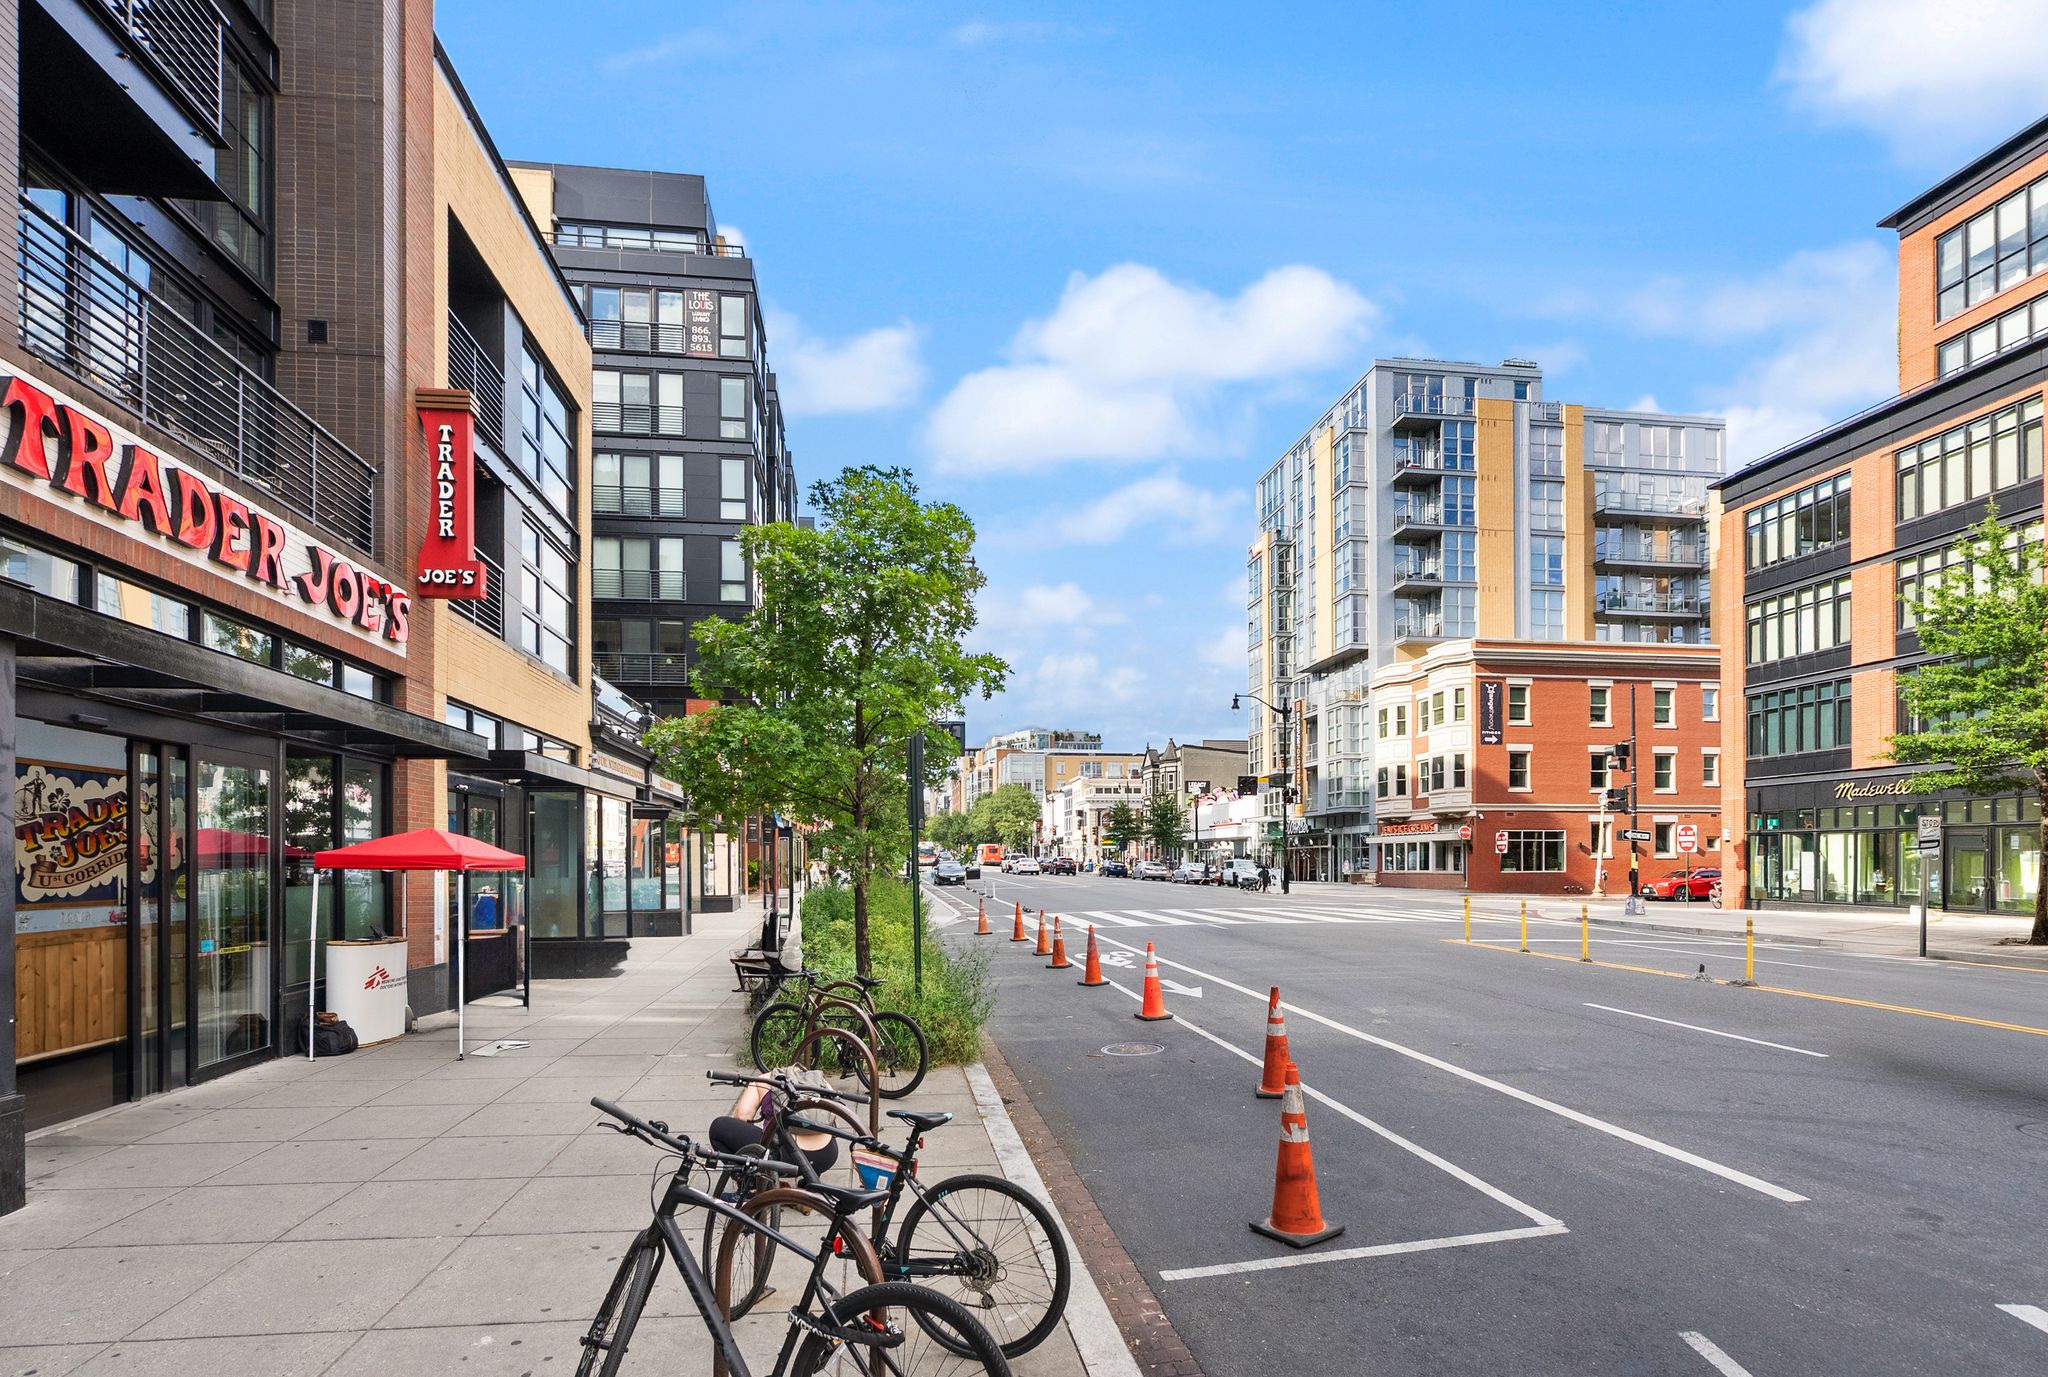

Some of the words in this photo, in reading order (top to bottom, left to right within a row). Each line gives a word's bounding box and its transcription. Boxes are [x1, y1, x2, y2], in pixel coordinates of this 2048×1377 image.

[692, 291, 711, 301] THE
[688, 300, 714, 311] LOUIS
[690, 344, 713, 352] 5615
[436, 424, 456, 538] TRADER
[0, 376, 289, 590] TRADER
[292, 546, 412, 644] JOE'S
[418, 568, 476, 585] JOE'S
[1834, 779, 1912, 802] Madewell
